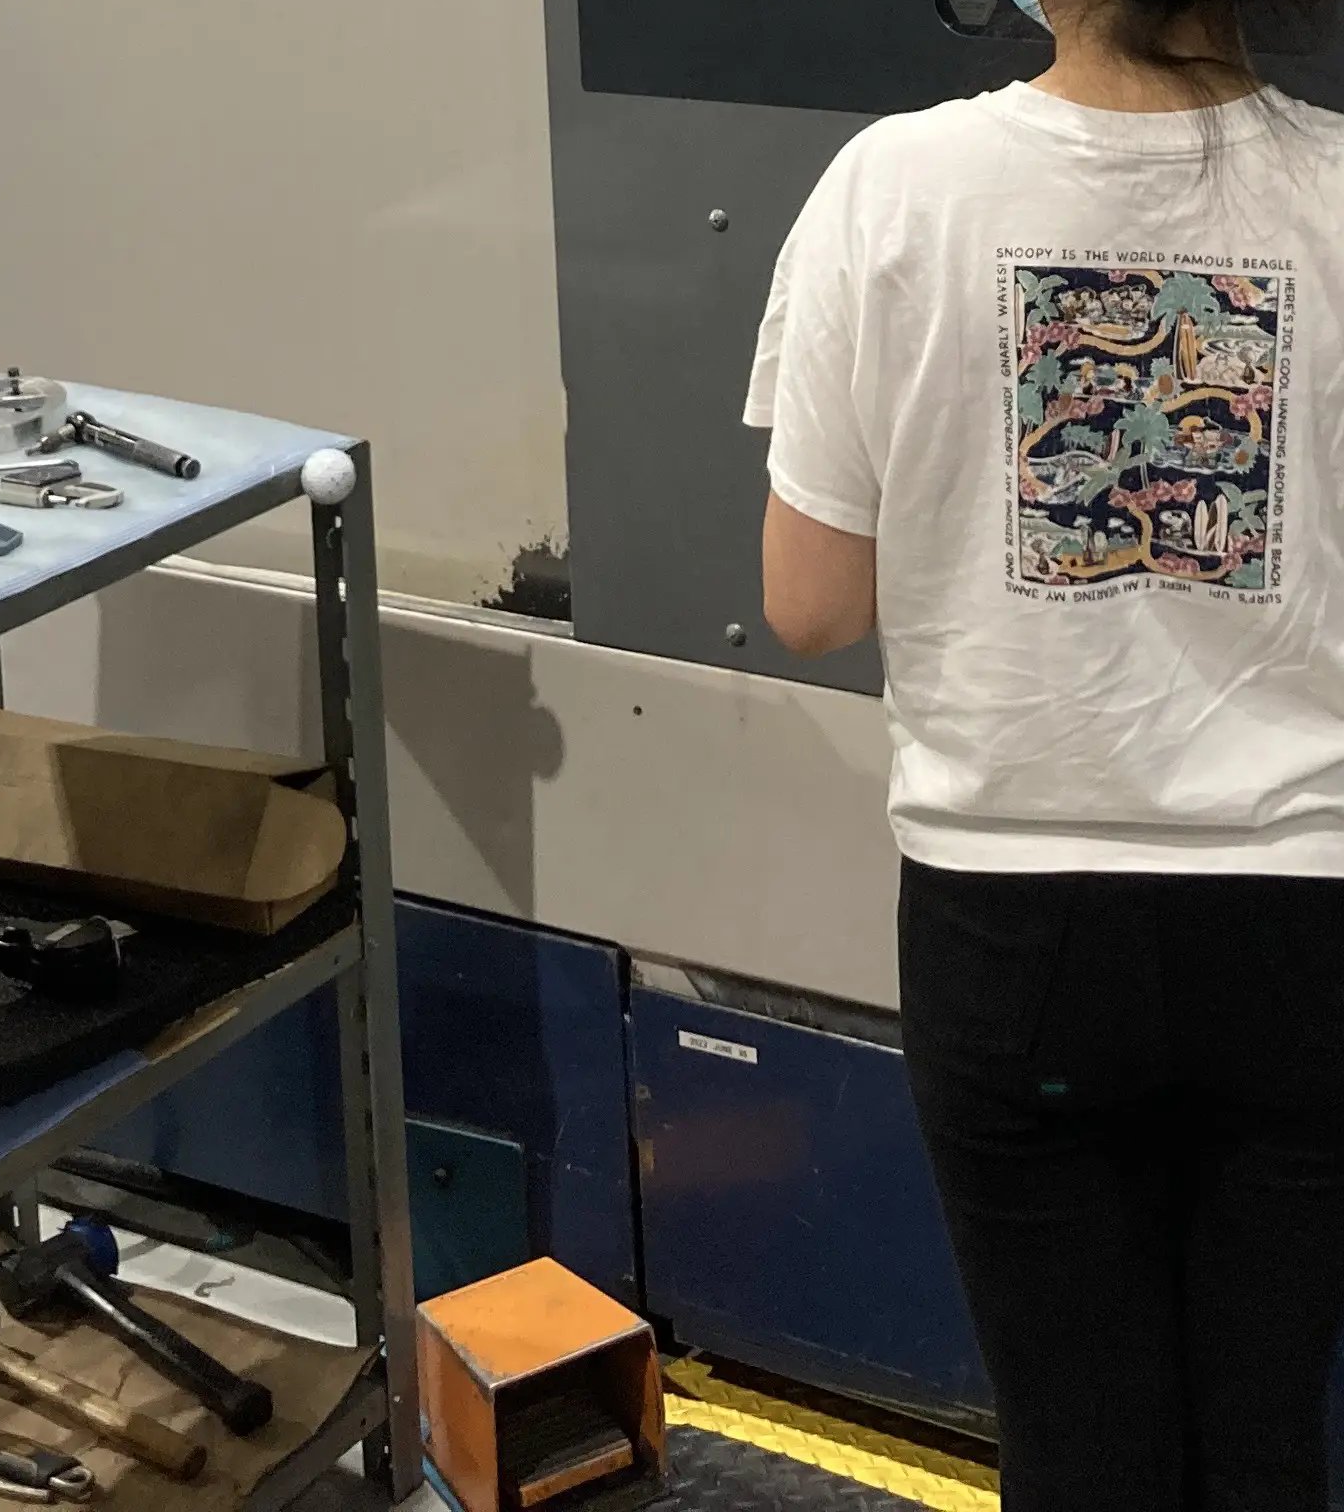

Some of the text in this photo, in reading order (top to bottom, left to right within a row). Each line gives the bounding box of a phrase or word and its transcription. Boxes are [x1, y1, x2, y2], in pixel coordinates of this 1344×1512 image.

[996, 246, 1053, 259] SNOOPY
[1061, 249, 1077, 260] IS
[1085, 250, 1109, 262] THE
[1116, 251, 1165, 264] WORLD
[1173, 254, 1233, 269] FAMOUS
[996, 263, 1009, 318] WAVES!
[1282, 277, 1296, 323] HERE'S
[1281, 327, 1294, 351] JOE
[998, 325, 1012, 378] GNARLY
[1278, 357, 1292, 393] COOL
[1274, 397, 1289, 459] HANGING
[1003, 473, 1013, 495] MY
[1273, 463, 1288, 517] AROUND
[1004, 499, 1014, 547] RIDING
[1271, 520, 1284, 544] THE
[1004, 552, 1015, 580] AND
[1045, 590, 1066, 603] MY
[1122, 579, 1139, 593] AM
[1159, 579, 1192, 593] HERE
[1208, 587, 1230, 600] UP!
[1238, 592, 1282, 604] SURF'S
